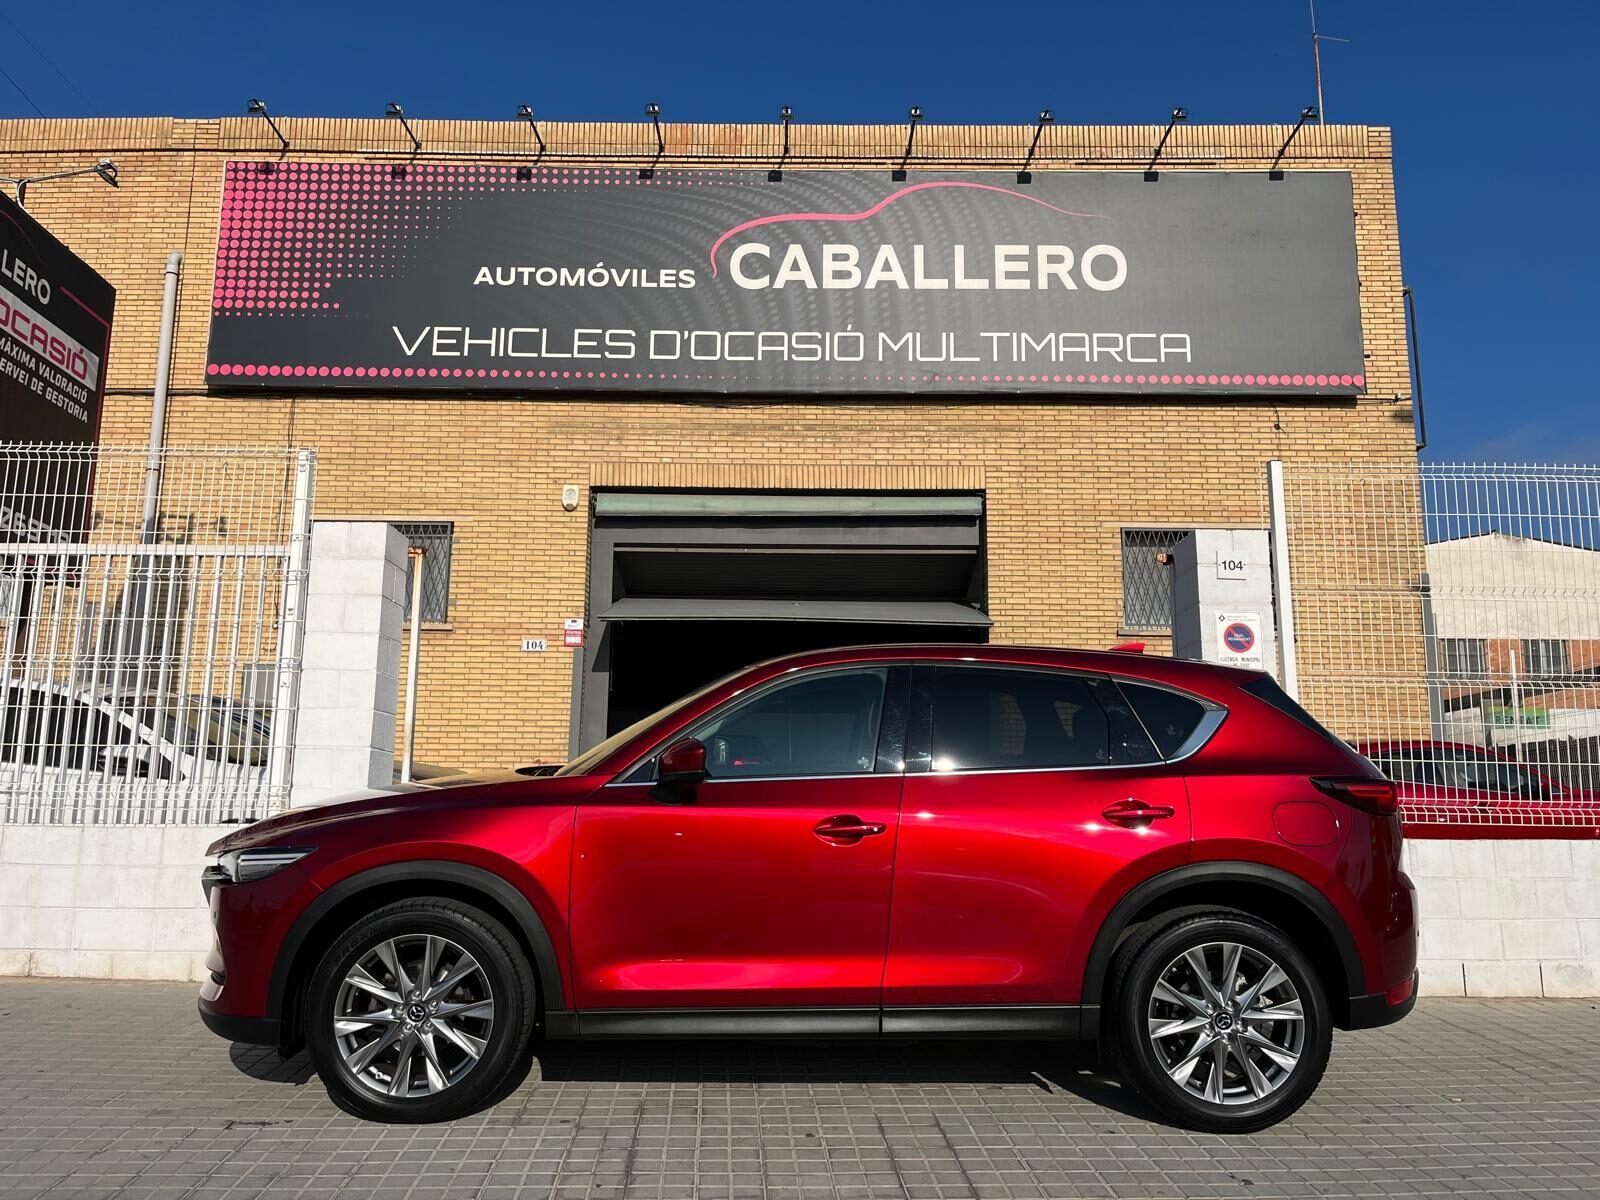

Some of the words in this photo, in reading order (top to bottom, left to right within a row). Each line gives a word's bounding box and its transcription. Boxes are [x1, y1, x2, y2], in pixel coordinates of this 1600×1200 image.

[473, 261, 696, 289] AUTOMÓVILES
[729, 243, 1128, 291] CABALLERO
[392, 326, 636, 358] VEHICLES
[649, 324, 864, 362] D'OCASIÓ
[878, 332, 1192, 363] MULTIMARCA
[30, 377, 45, 396] DE
[46, 387, 88, 424] GESTORIA
[39, 362, 88, 404] VALORACIÓ
[1221, 560, 1244, 571] 104
[526, 640, 543, 650] 104
